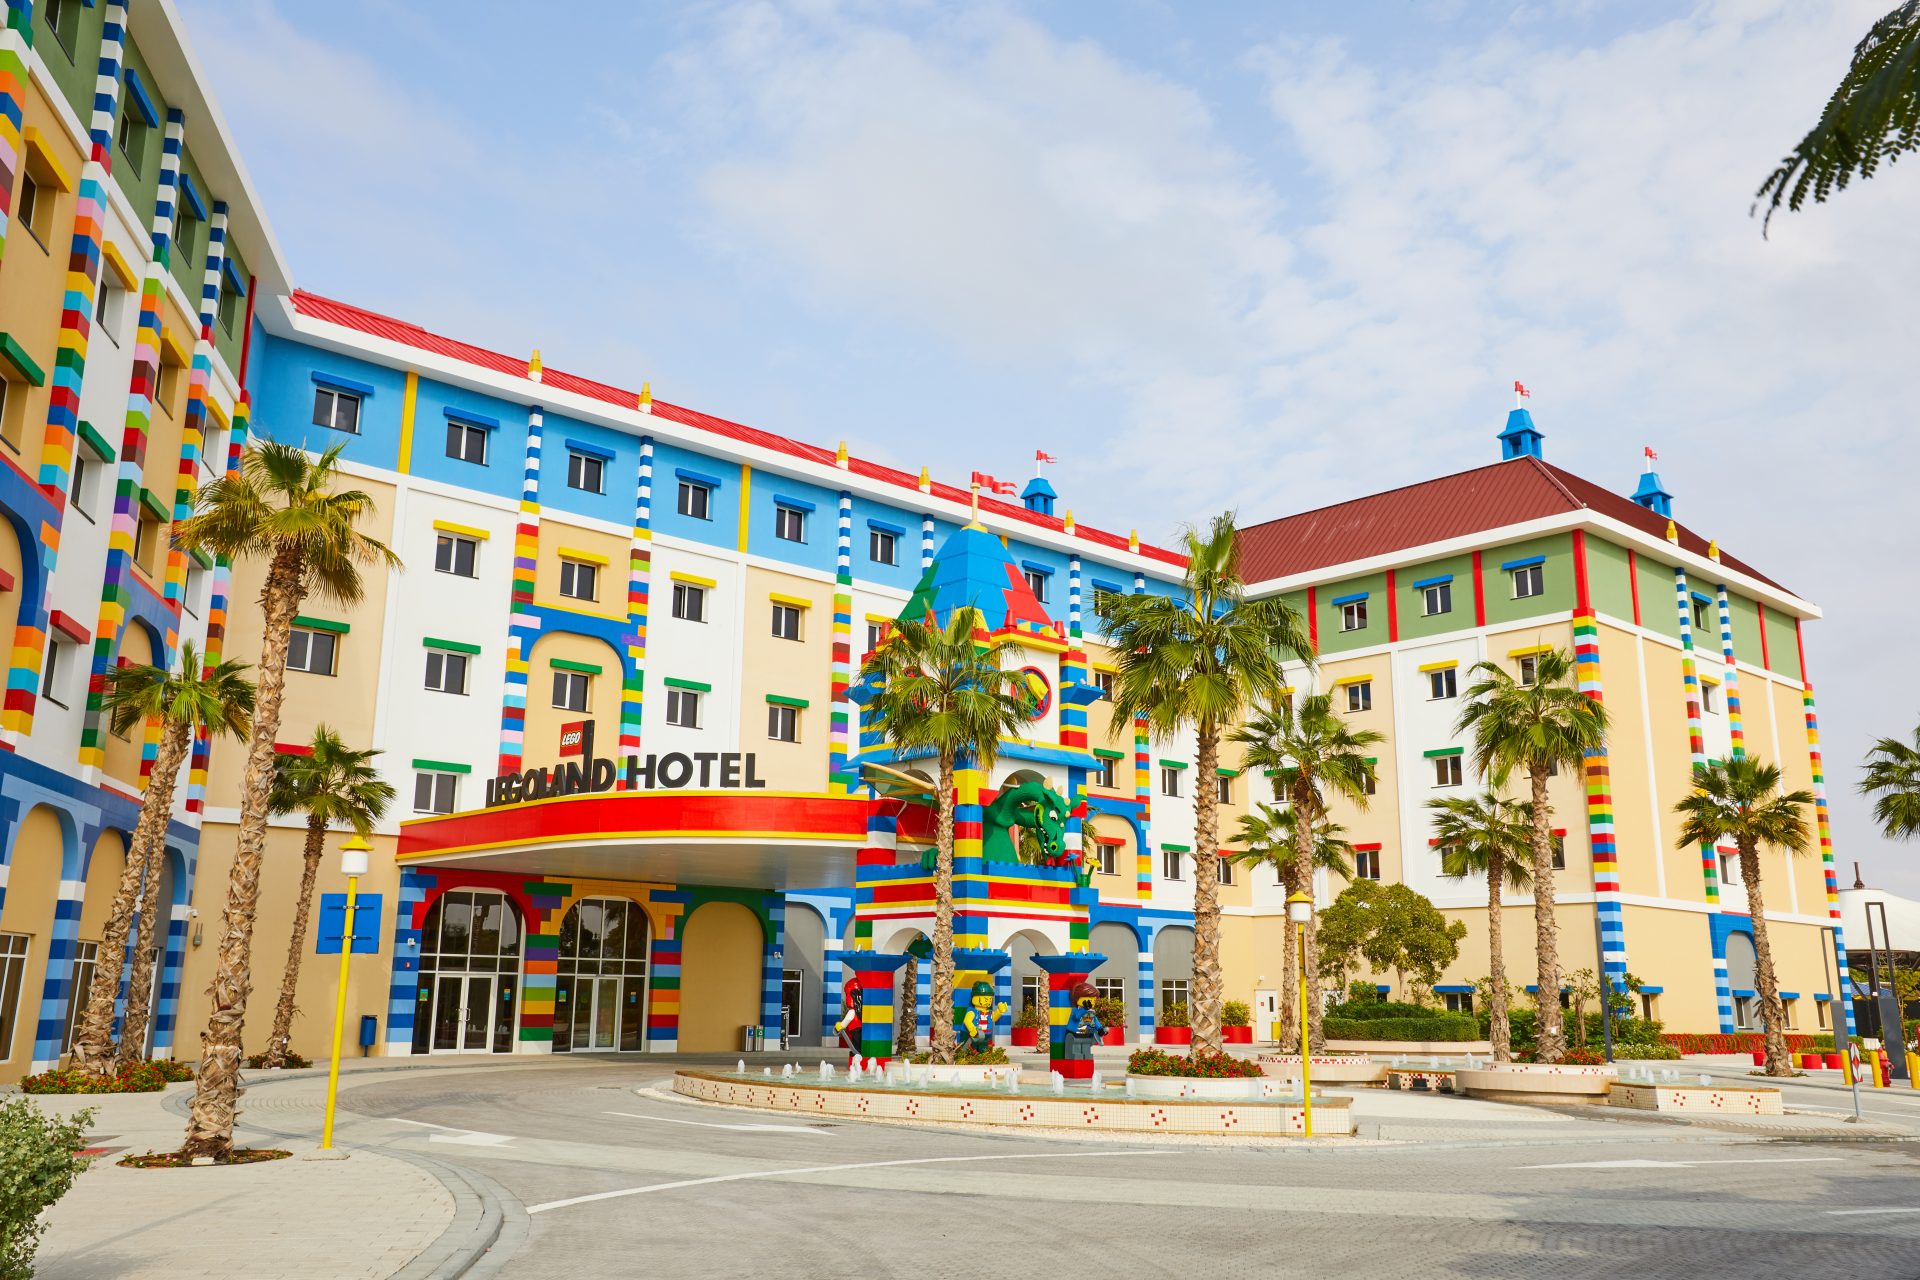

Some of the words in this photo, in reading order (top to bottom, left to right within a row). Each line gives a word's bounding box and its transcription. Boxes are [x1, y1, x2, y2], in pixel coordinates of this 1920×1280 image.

[561, 731, 581, 746] LEGO
[486, 757, 617, 808] LEGOLAND
[625, 752, 766, 790] HOTEL
